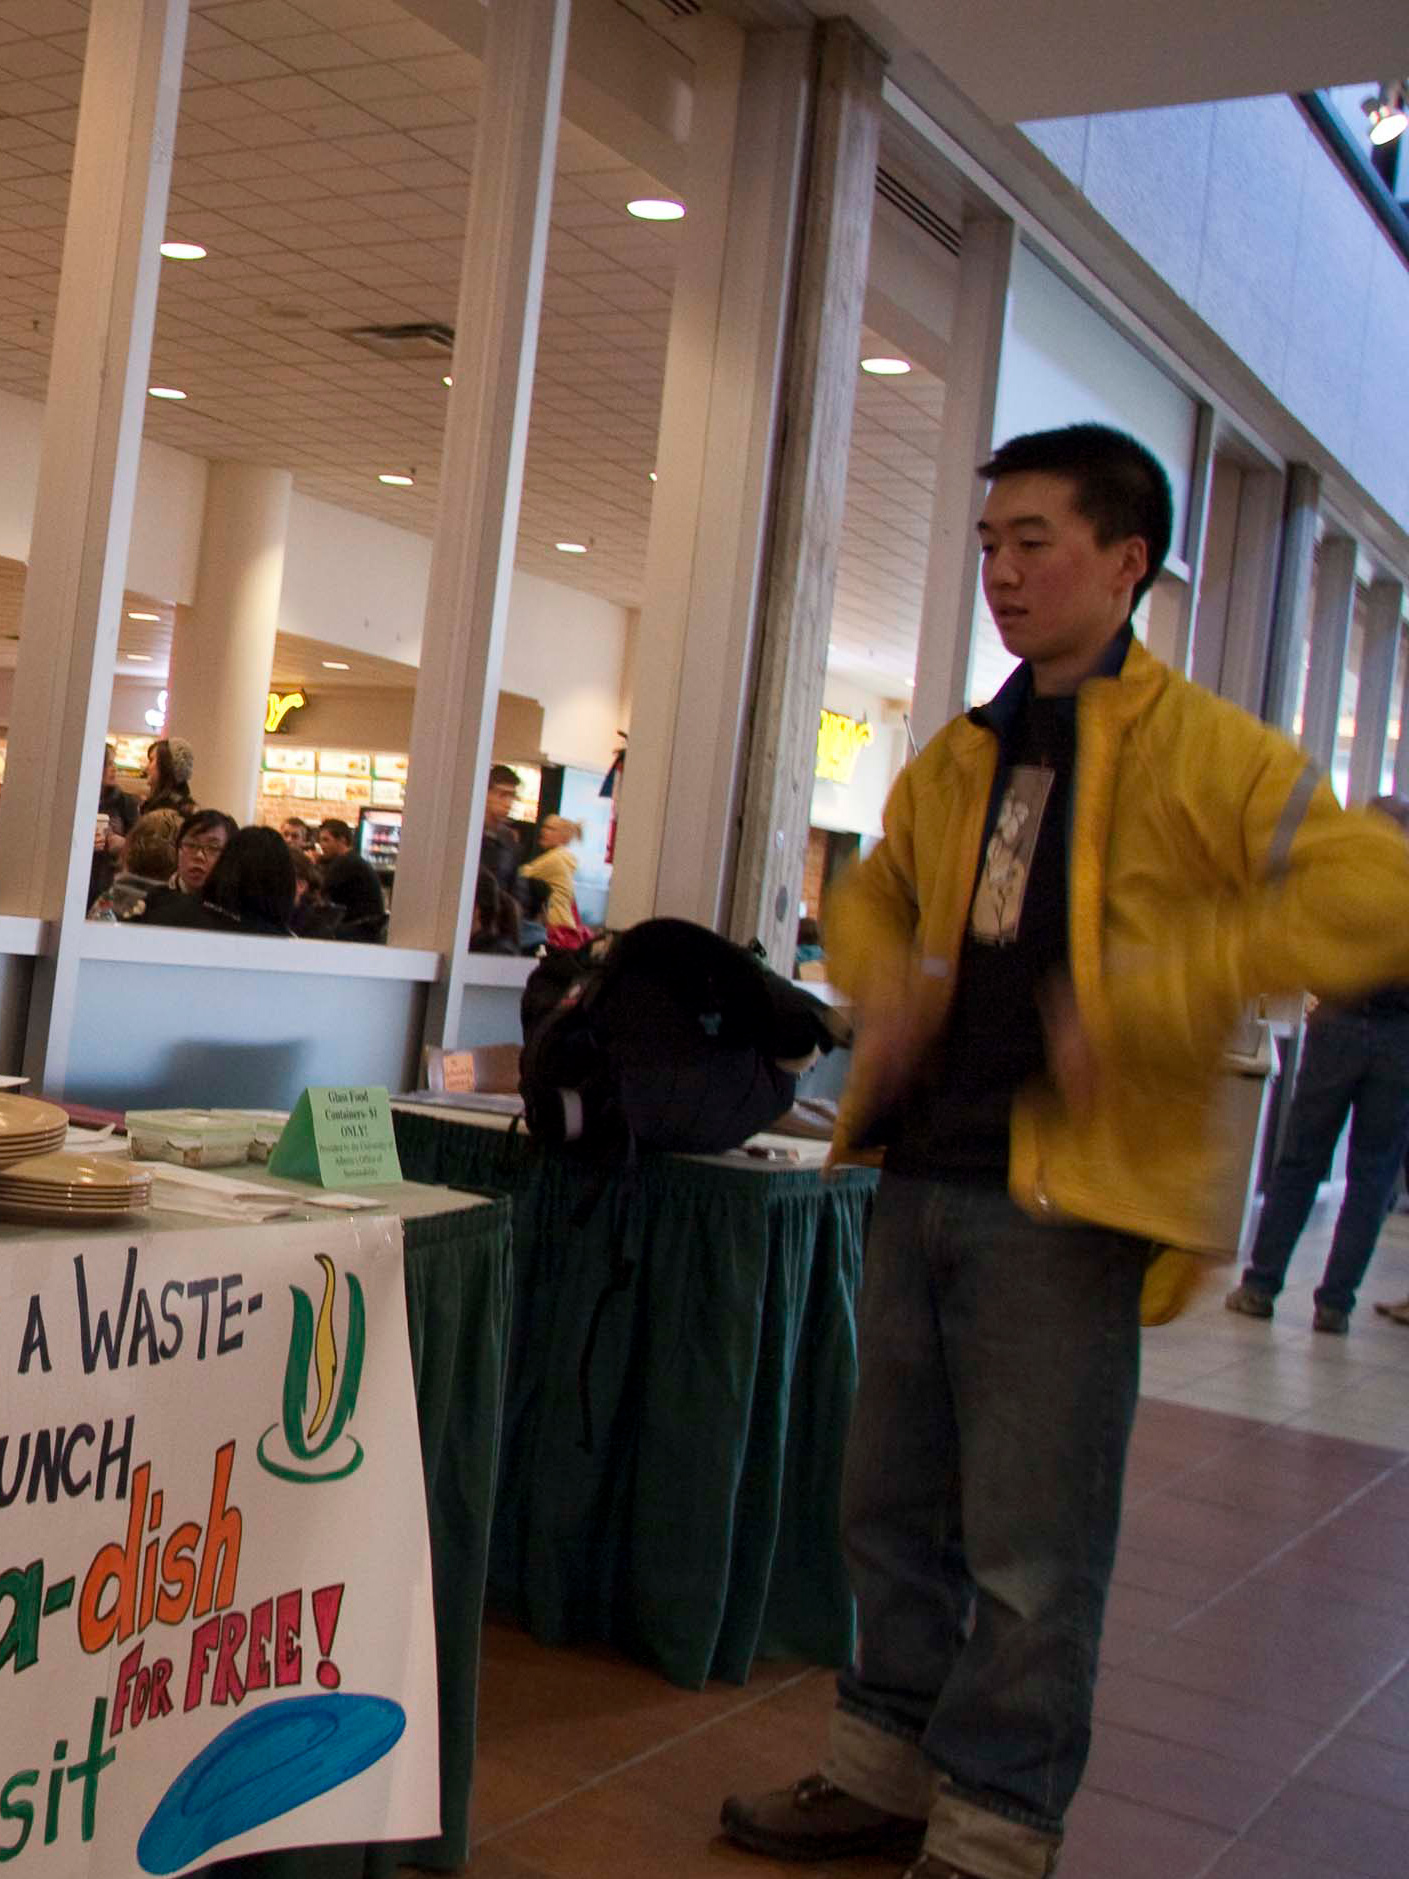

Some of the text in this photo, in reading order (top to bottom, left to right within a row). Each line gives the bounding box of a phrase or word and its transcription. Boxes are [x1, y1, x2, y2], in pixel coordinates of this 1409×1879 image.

[17, 1295, 52, 1374] A
[110, 1583, 345, 1737] FOR FREE!
